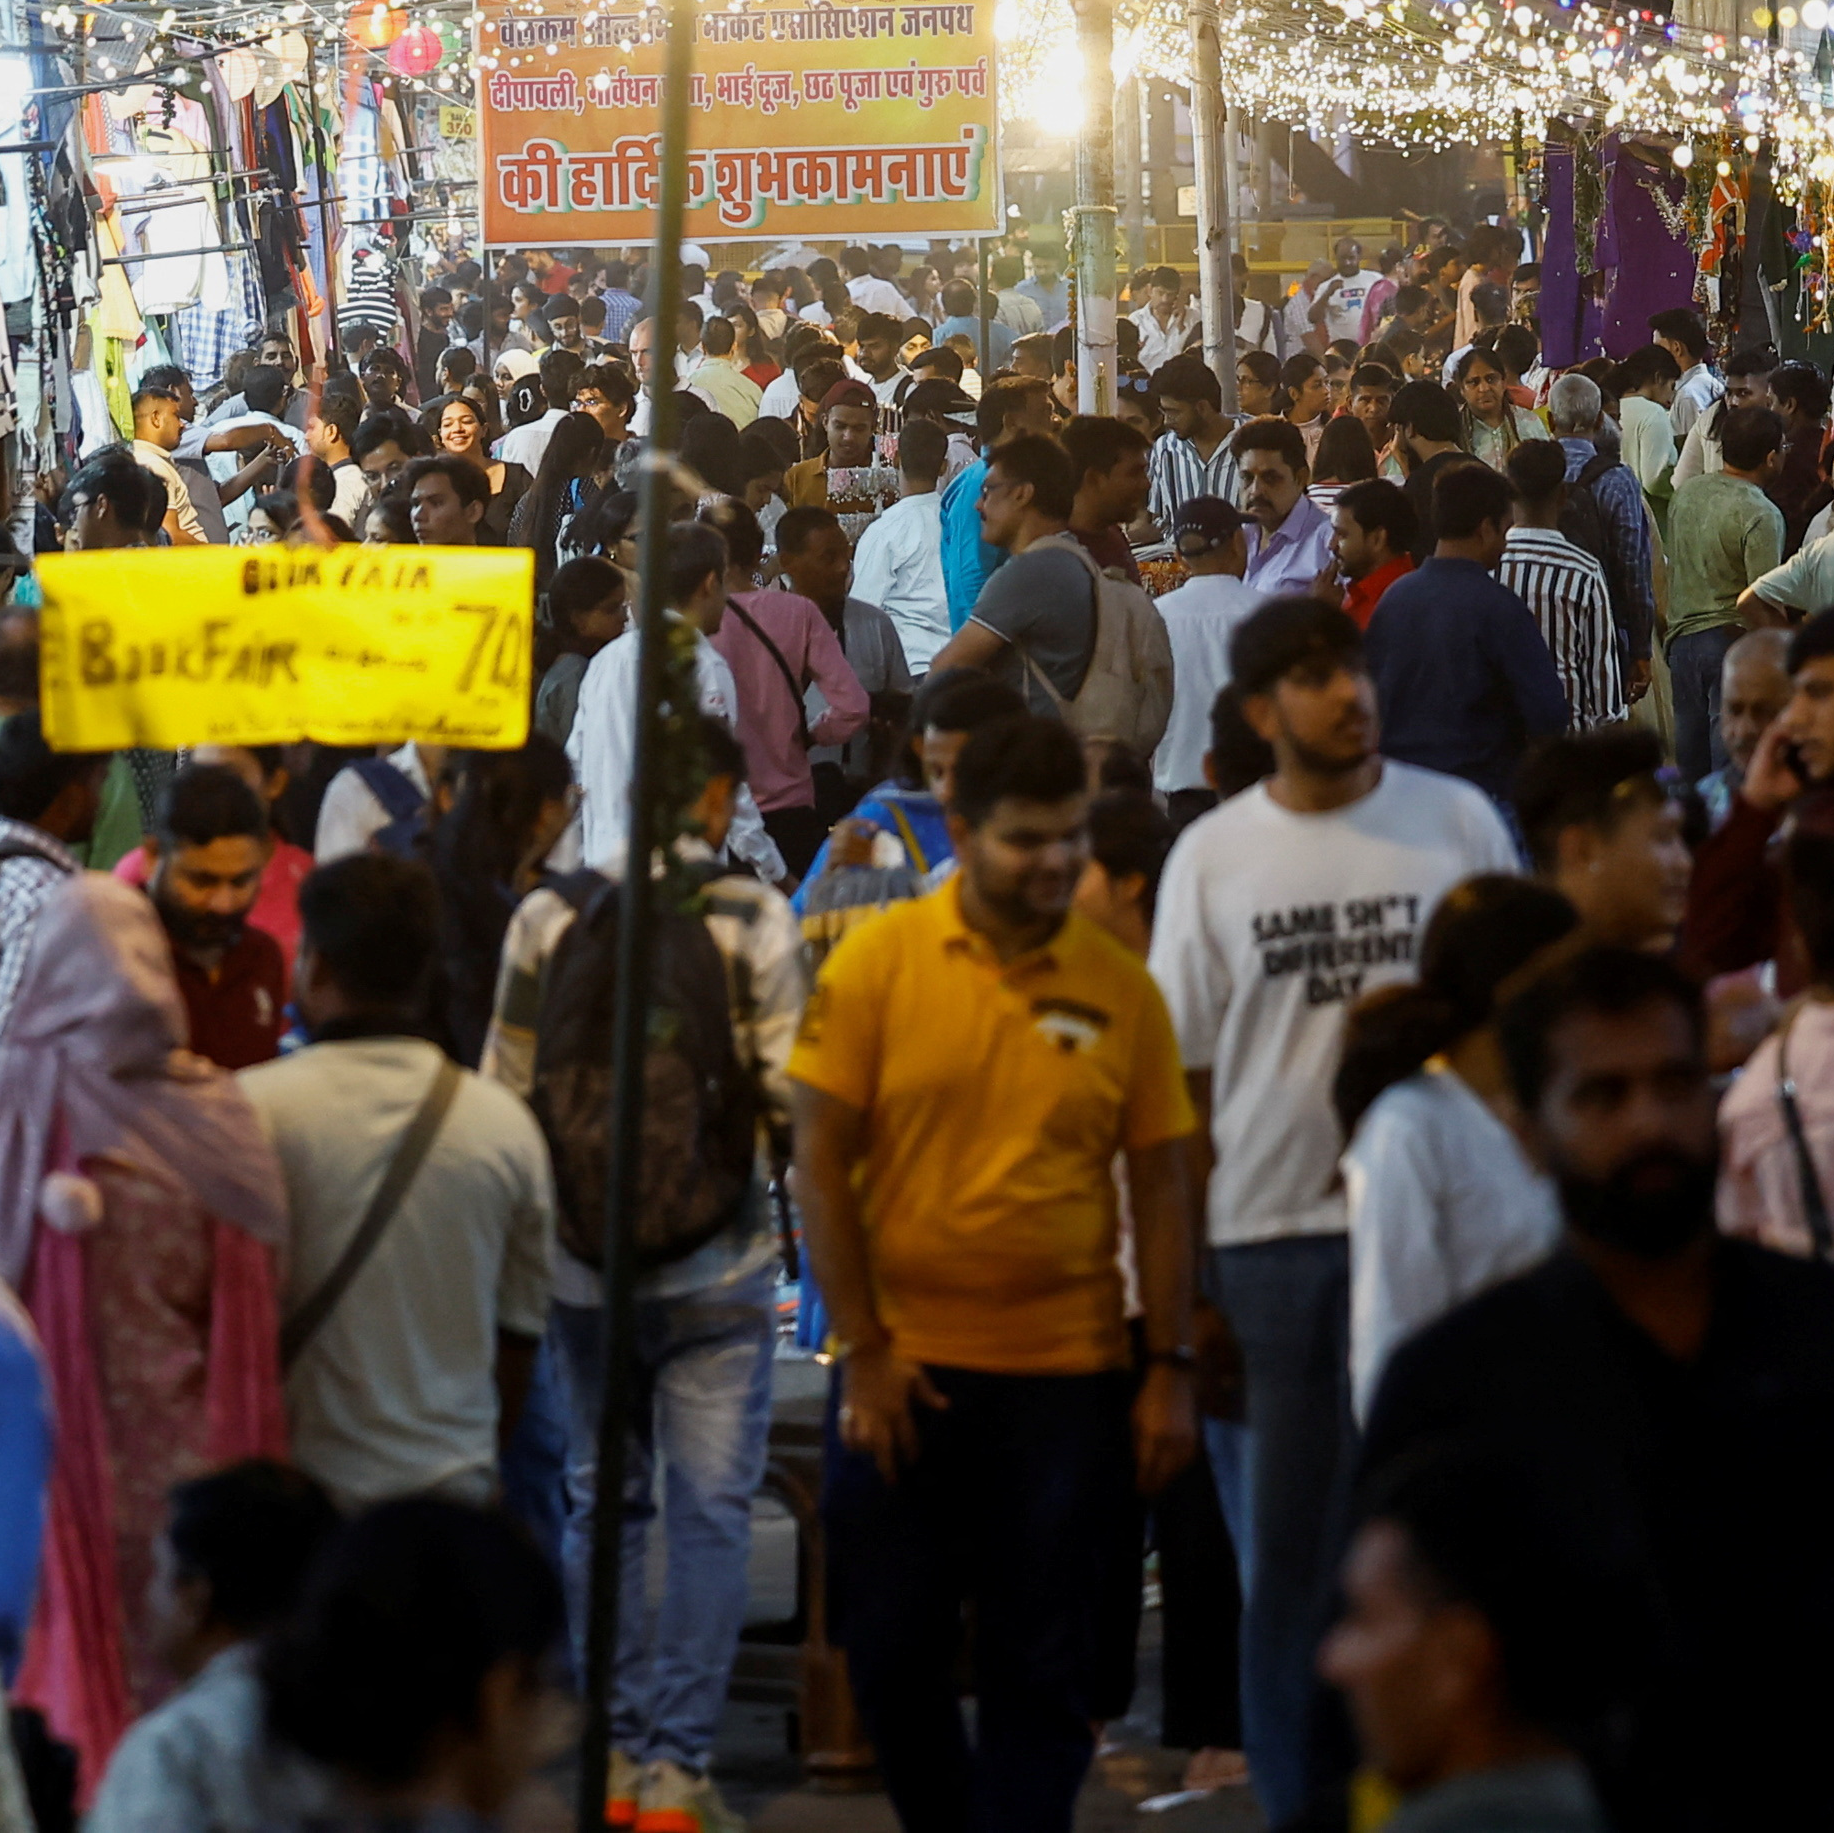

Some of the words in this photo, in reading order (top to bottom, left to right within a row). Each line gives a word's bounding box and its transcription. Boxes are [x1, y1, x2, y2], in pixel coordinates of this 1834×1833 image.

[899, 4, 975, 37] जनपथ
[489, 69, 585, 115] दीपावली,
[715, 62, 756, 109] भाई
[757, 70, 800, 115] दूज,
[804, 70, 836, 102] छठ
[838, 70, 883, 112] पूजा
[884, 58, 917, 100] एवं
[917, 67, 954, 109] गुरु
[955, 55, 988, 98] पर्व
[497, 140, 563, 208] की
[713, 127, 976, 223] शुभकामनाएं
[1253, 901, 1335, 943] SAME
[1264, 932, 1415, 977] DIFFERENT
[1307, 971, 1362, 1006] DAY
